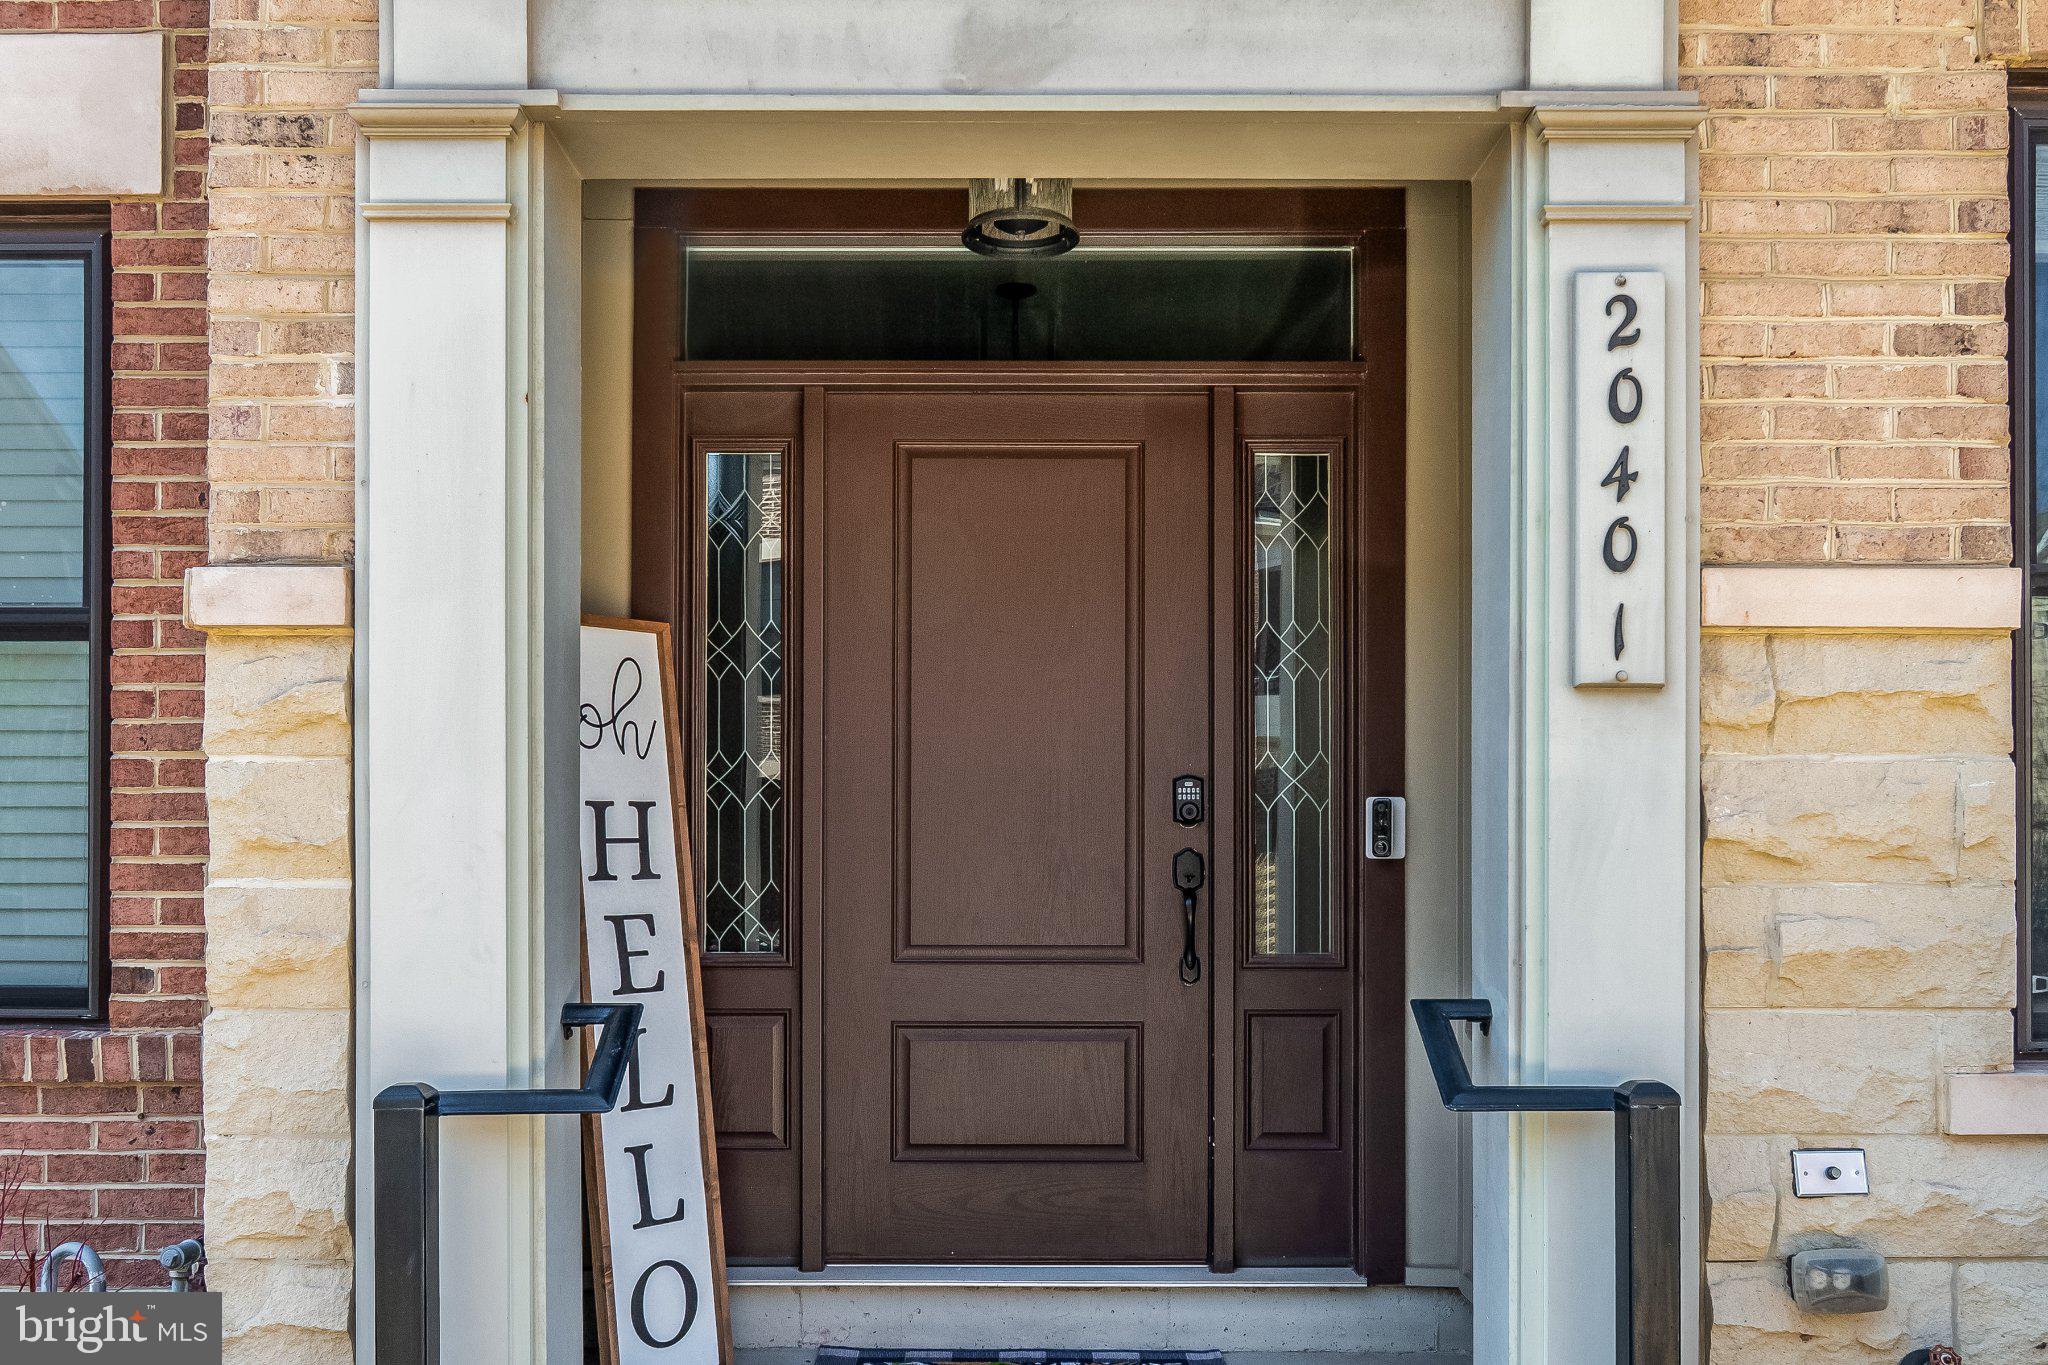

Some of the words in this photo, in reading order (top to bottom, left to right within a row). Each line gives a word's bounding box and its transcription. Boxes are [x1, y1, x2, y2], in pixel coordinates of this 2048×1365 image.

[1601, 294, 1643, 660] 20401
[579, 656, 657, 759] oh
[584, 799, 698, 1349] HELLO
